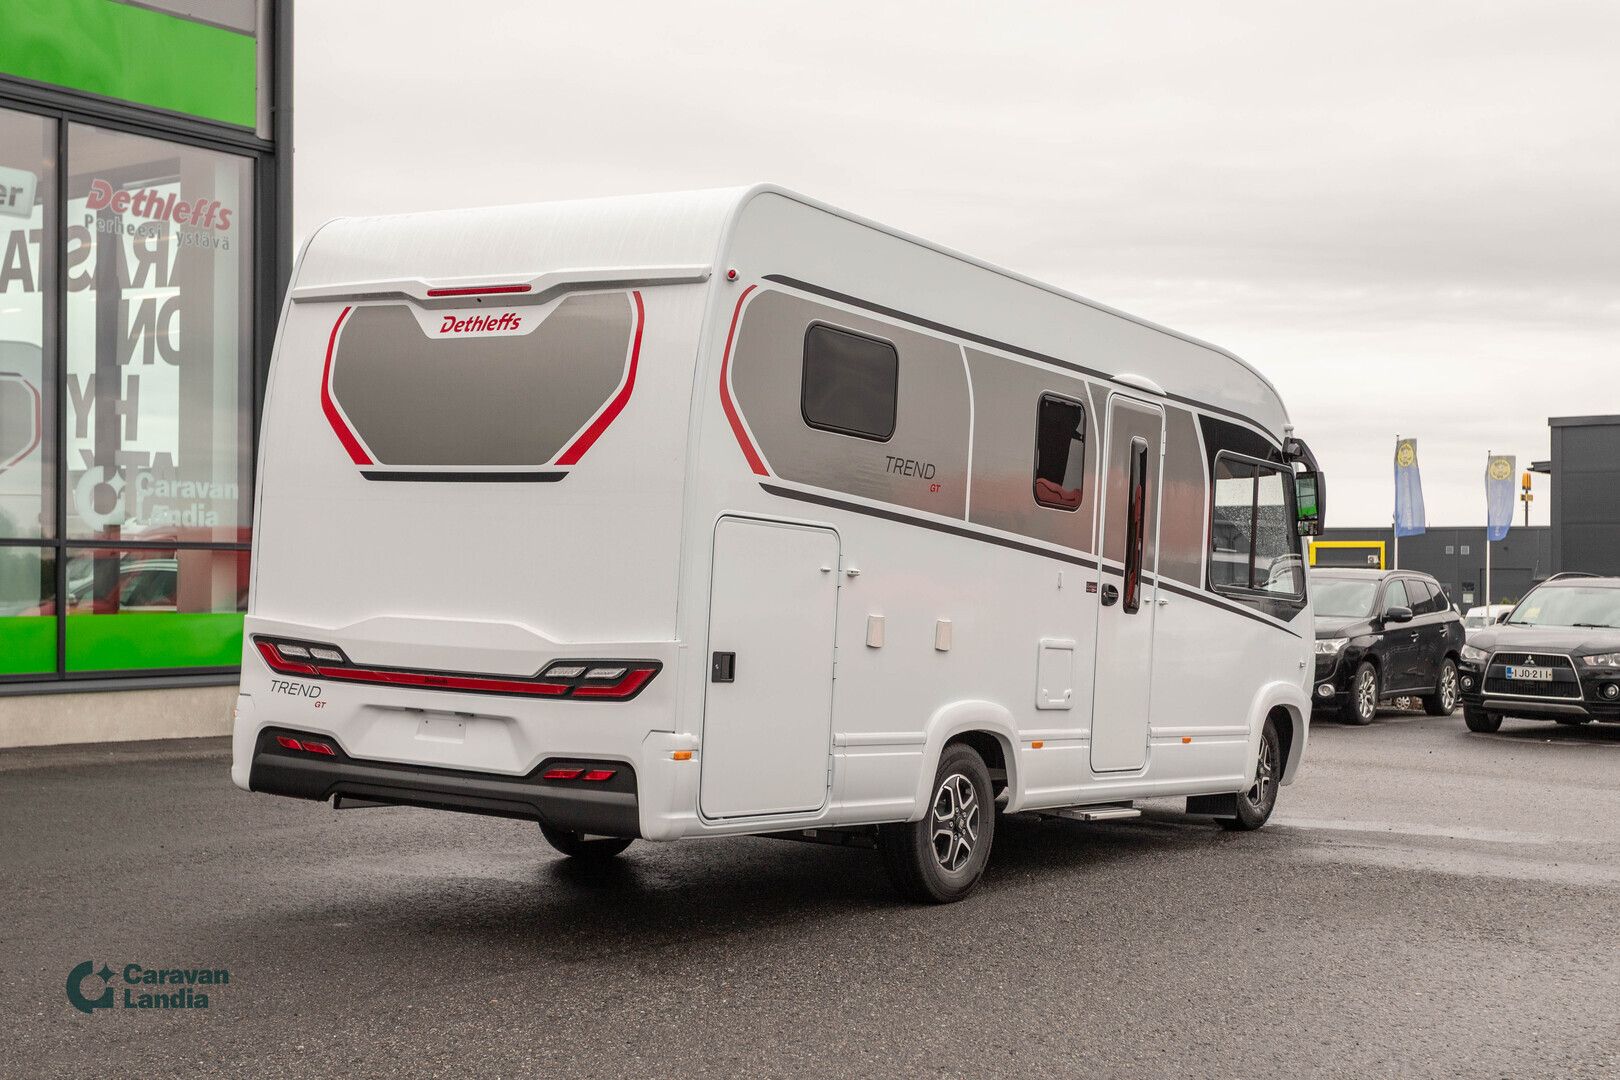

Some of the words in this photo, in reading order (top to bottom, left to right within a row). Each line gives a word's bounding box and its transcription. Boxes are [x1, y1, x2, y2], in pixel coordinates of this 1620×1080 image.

[85, 178, 233, 231] Dethleffs
[85, 214, 161, 240] Perheesi
[176, 230, 230, 250] ystävä
[440, 312, 521, 333] Dethleffs
[886, 455, 936, 480] TREND
[136, 471, 239, 499] Caravan
[930, 484, 941, 493] GT
[271, 680, 322, 698] TREND
[314, 701, 326, 709] GT
